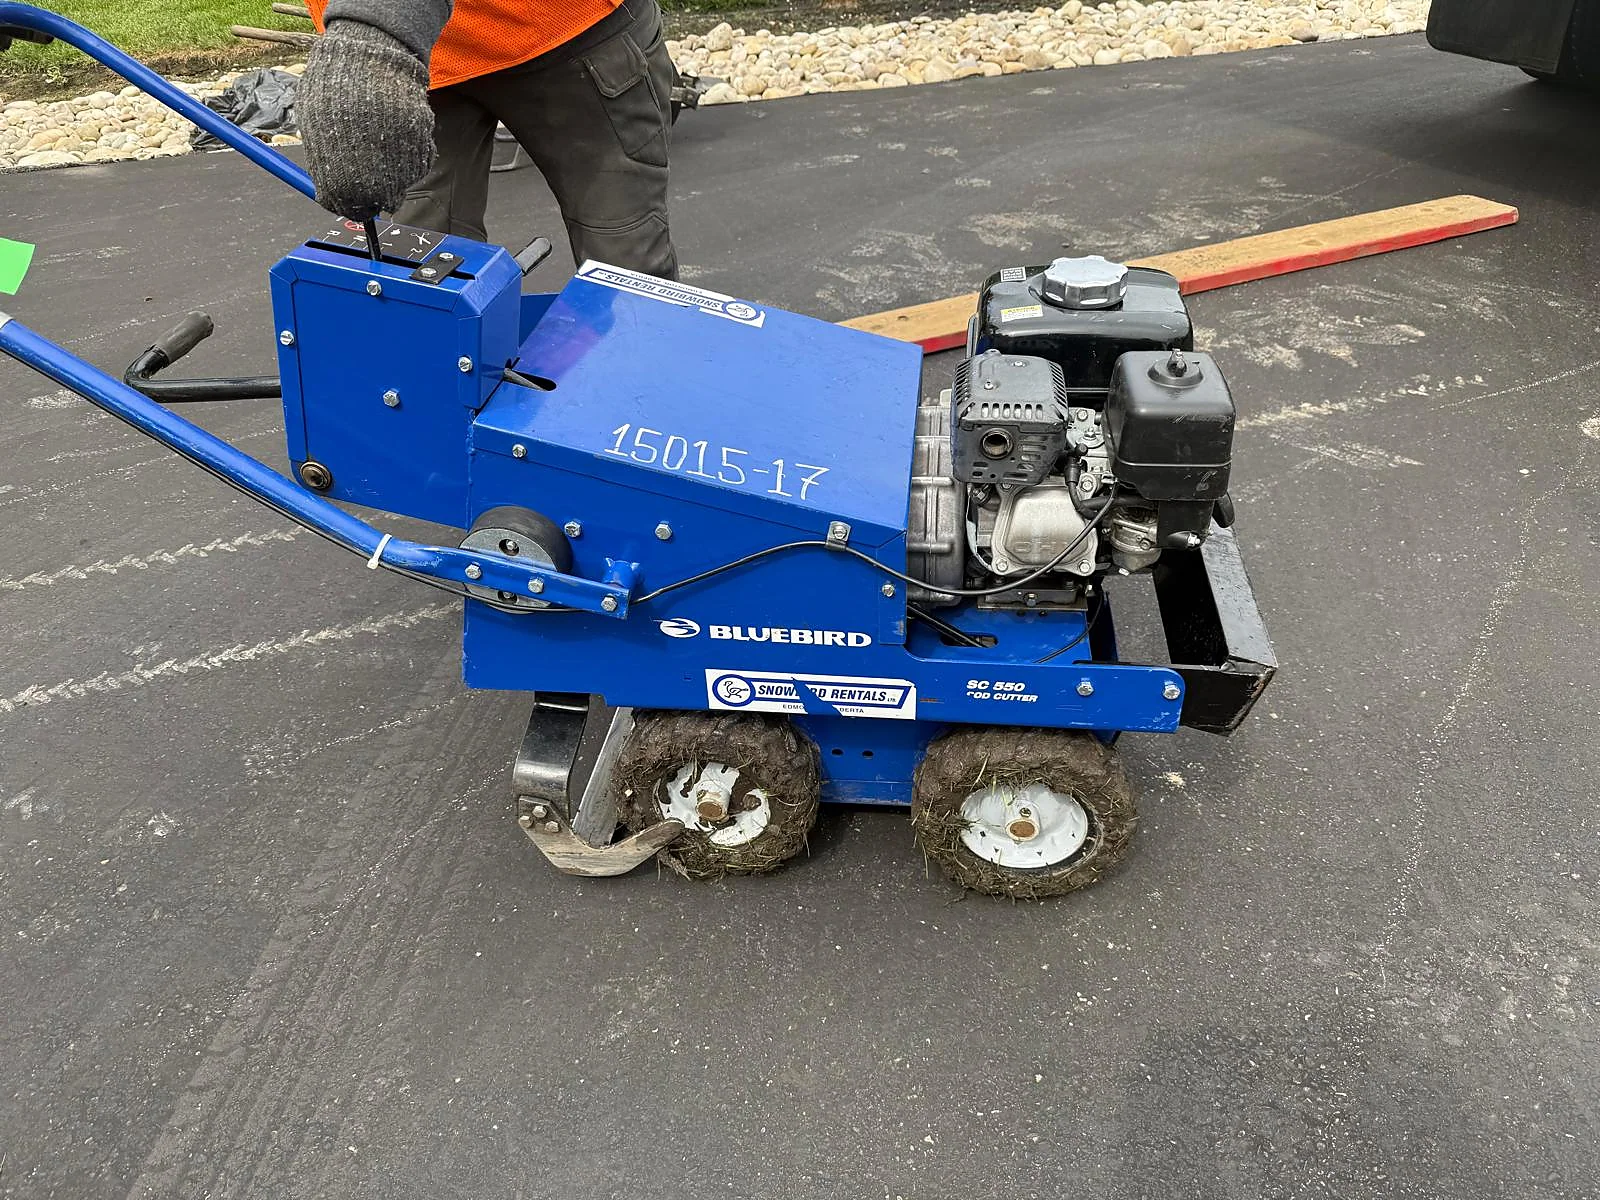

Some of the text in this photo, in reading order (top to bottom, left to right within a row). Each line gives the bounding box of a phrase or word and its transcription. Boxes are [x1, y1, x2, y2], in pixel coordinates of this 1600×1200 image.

[605, 274, 656, 291] RENTALS
[657, 288, 720, 308] SNOWBIRD
[604, 423, 830, 500] 15015-17
[709, 625, 872, 647] BLUEBIRD
[966, 680, 1026, 692] SC 550
[830, 688, 887, 702] RENTALS
[993, 693, 1038, 702] CUTTER
